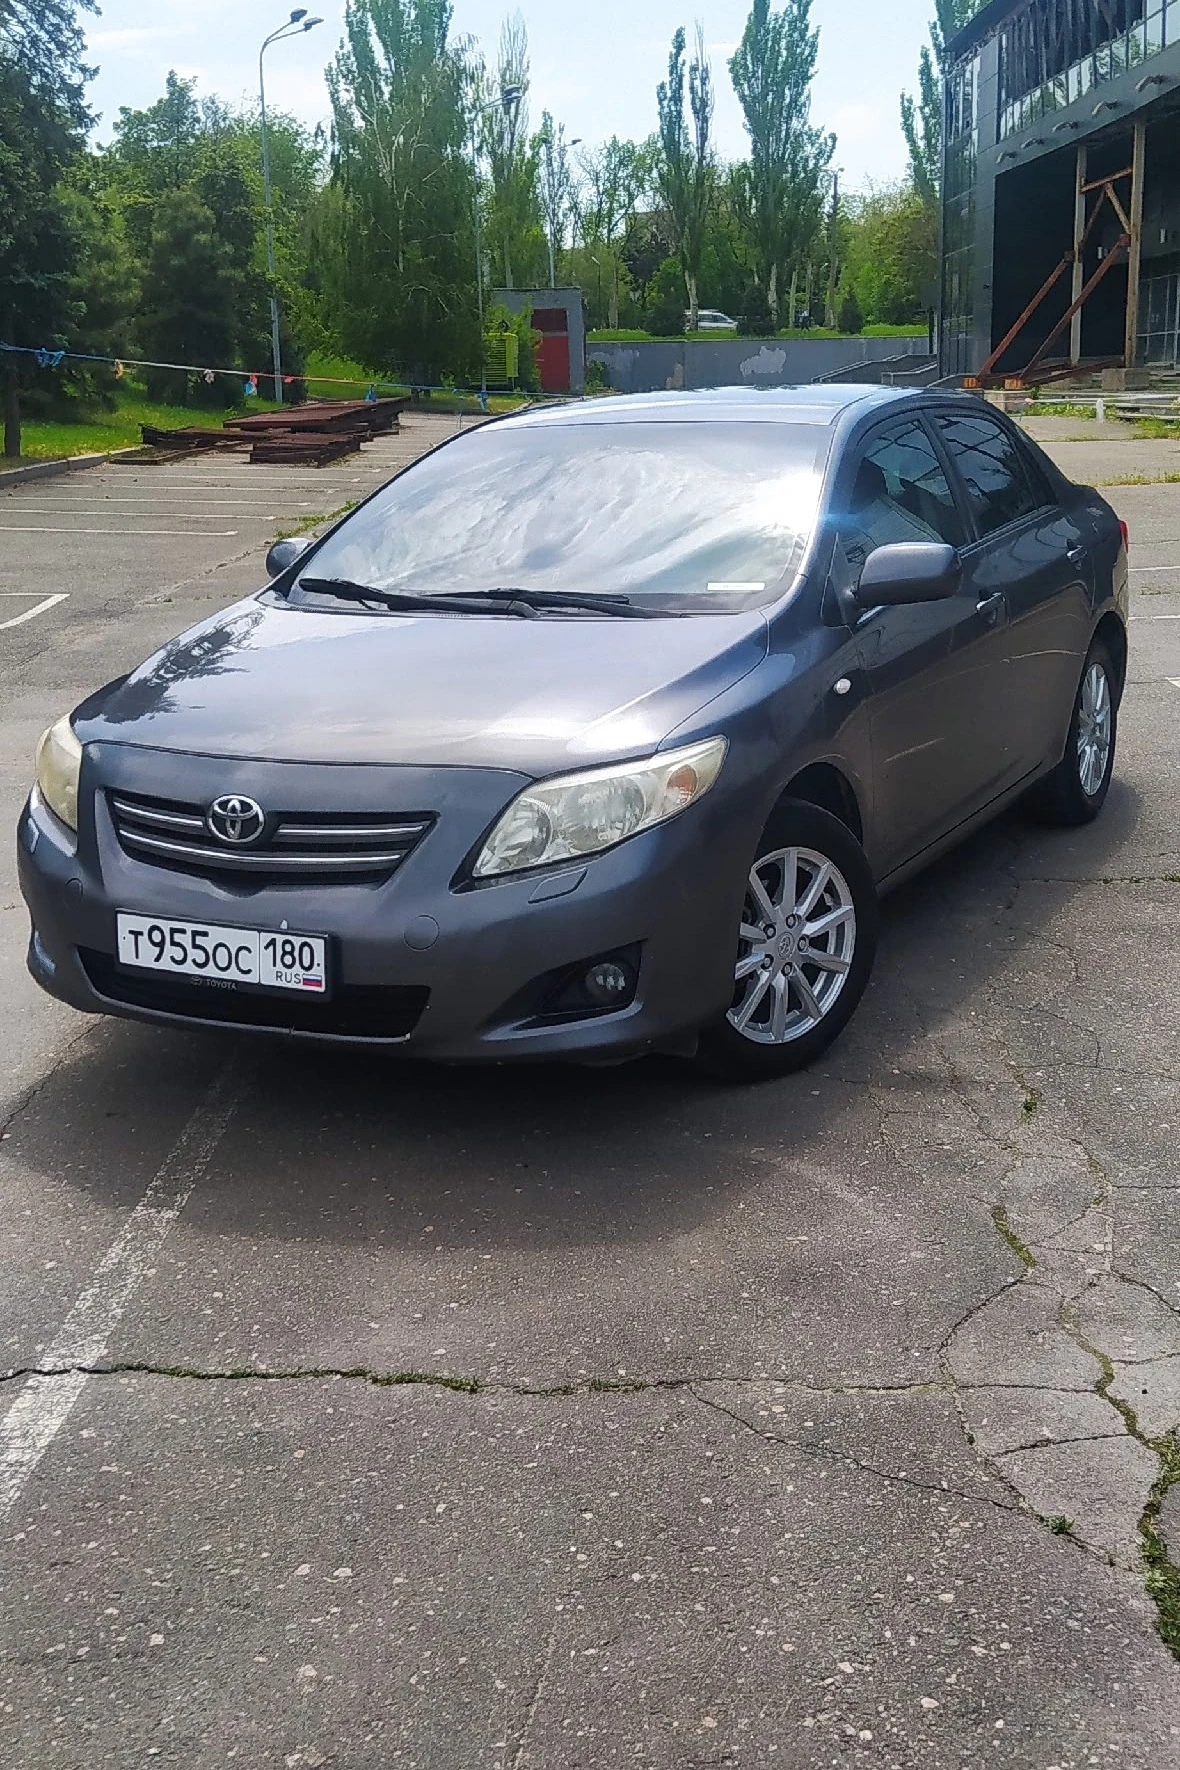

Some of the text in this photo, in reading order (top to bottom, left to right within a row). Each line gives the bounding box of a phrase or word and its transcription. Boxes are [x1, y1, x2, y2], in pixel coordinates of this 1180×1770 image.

[263, 937, 315, 972] 180
[206, 978, 237, 990] TOYOTA
[275, 970, 302, 984] RUS
